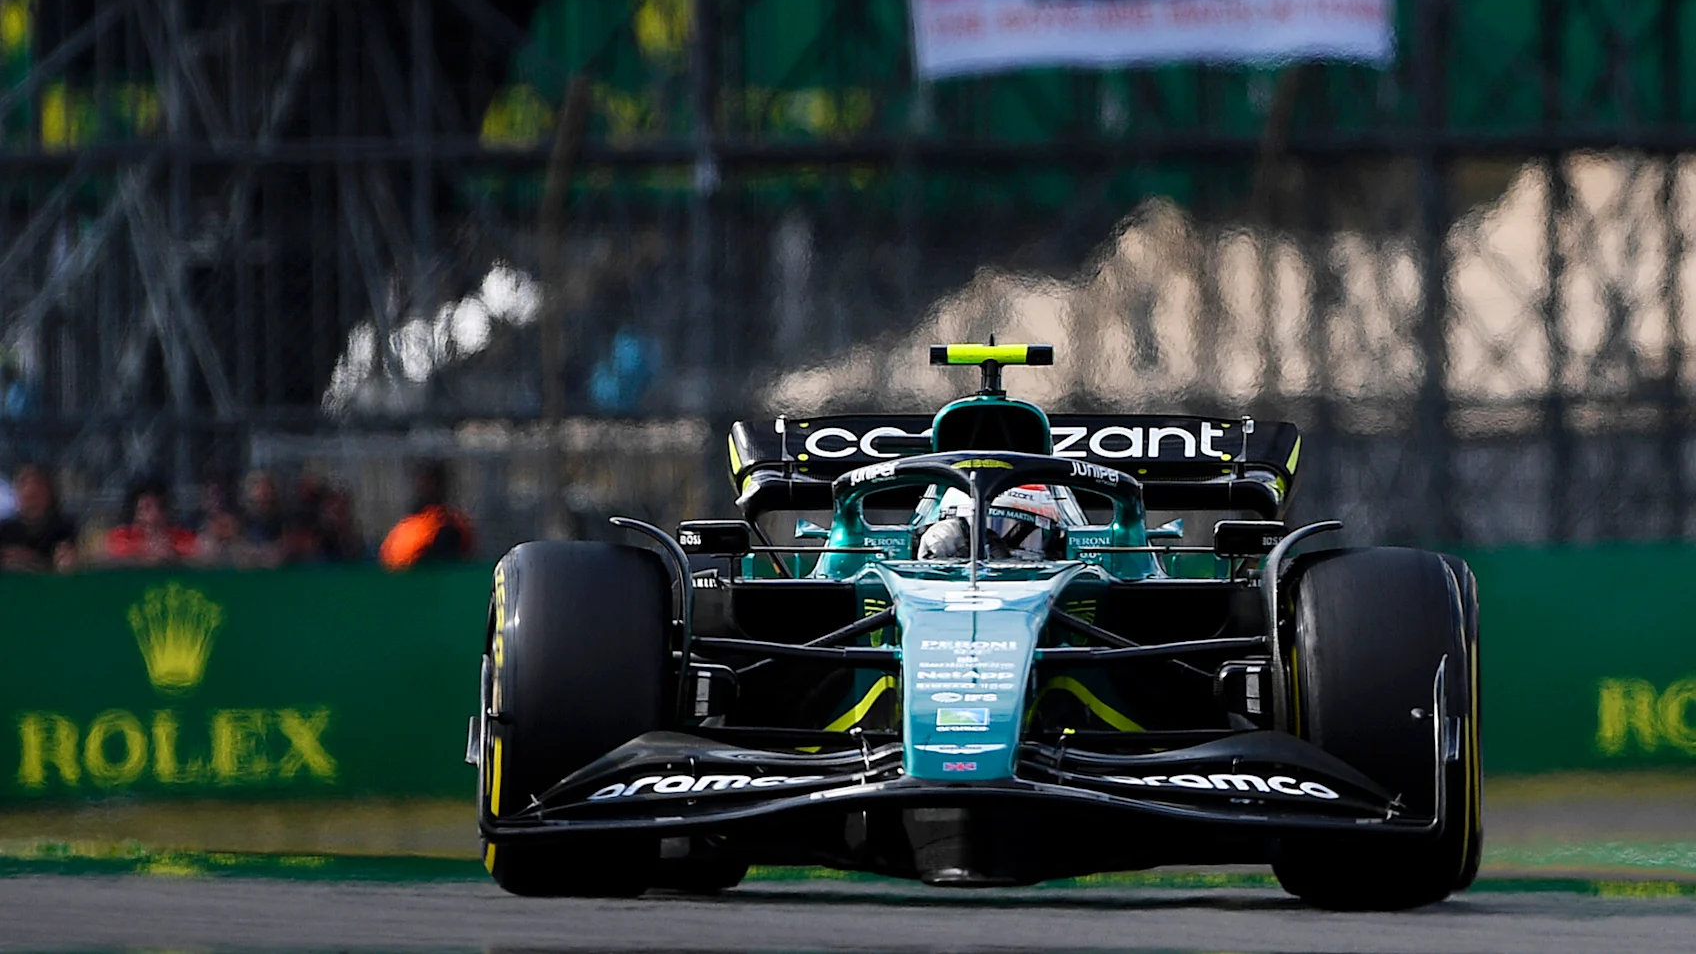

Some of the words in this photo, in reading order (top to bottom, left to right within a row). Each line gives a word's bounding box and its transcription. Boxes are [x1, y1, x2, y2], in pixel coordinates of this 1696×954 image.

[805, 421, 1224, 458] cozant
[864, 537, 906, 546] PERONI
[1068, 537, 1110, 546] PERONI
[916, 670, 1015, 680] NetApp
[17, 705, 338, 787] ROLEX
[587, 775, 825, 801] aramco
[1101, 774, 1341, 799] aramco
